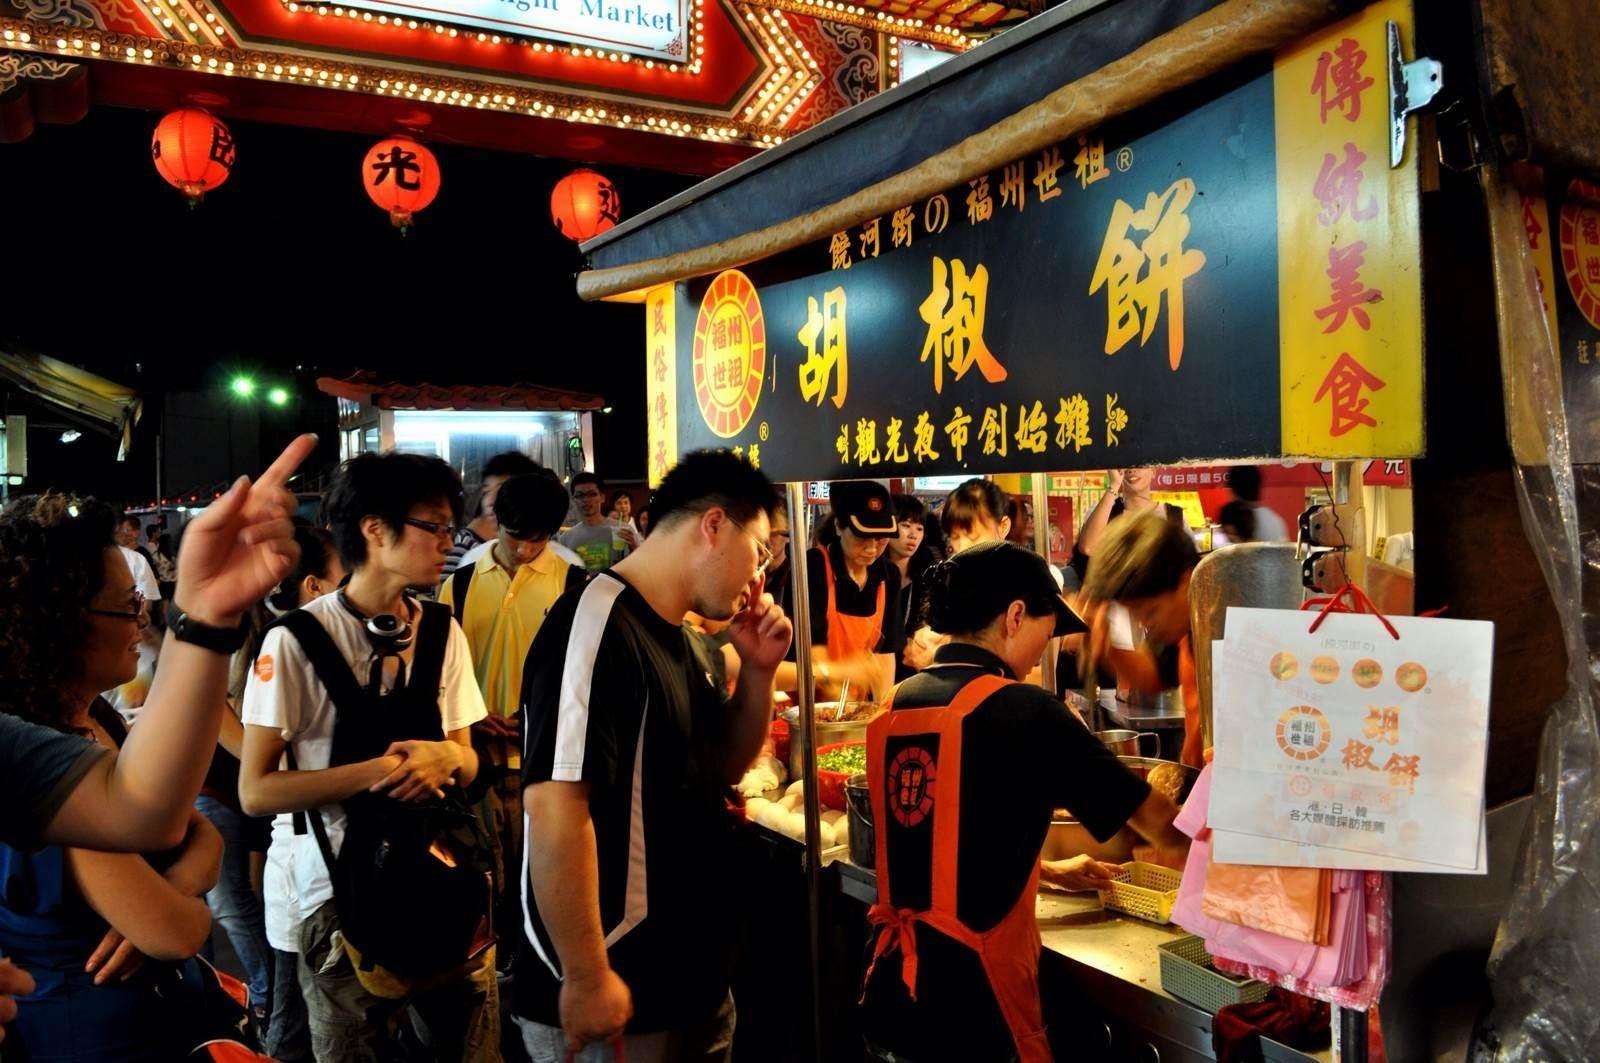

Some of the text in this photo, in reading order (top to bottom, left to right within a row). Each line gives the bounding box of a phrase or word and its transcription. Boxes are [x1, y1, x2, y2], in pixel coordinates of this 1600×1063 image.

[580, 0, 675, 33] Market
[371, 147, 422, 191] 光
[1312, 38, 1386, 437] 傳統美食
[797, 177, 1206, 410] 胡椒餅
[712, 315, 743, 351] 福州
[713, 356, 744, 390] 世祖
[854, 393, 1093, 467] 觀光夜市創始攤
